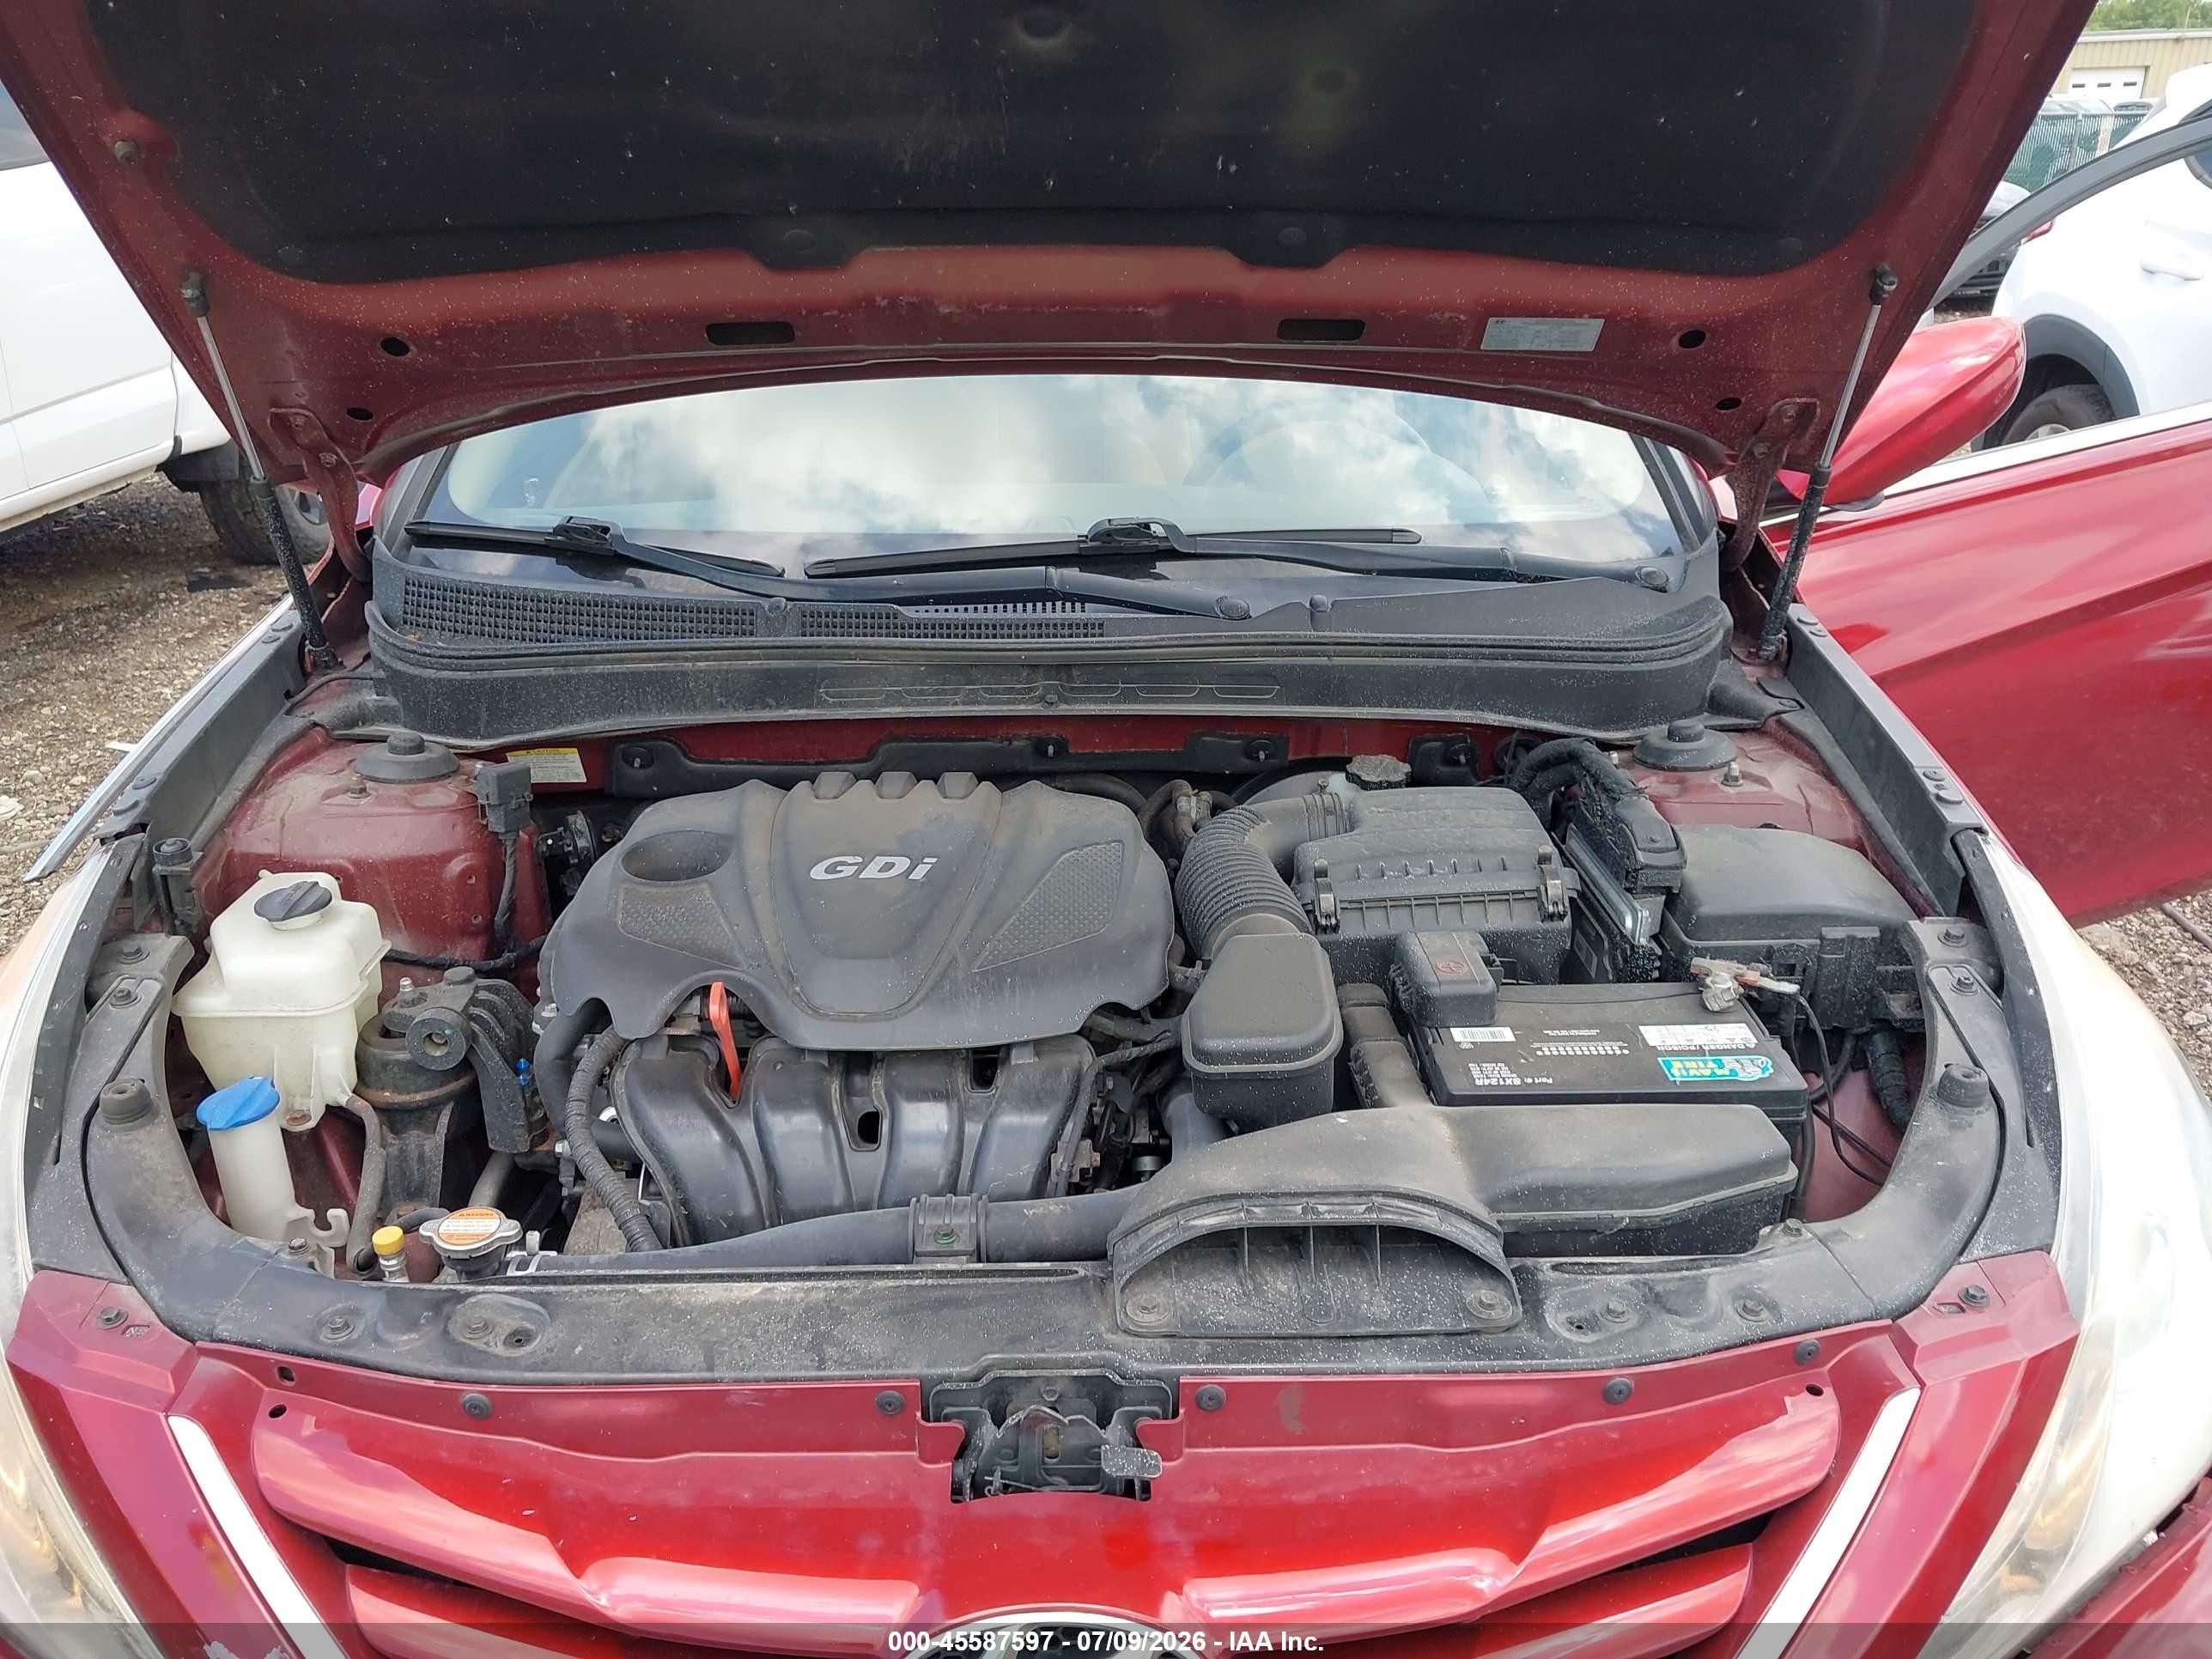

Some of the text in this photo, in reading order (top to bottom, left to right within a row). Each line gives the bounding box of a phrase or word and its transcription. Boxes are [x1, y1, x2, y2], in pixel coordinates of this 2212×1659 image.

[810, 855, 938, 880] GDi
[1701, 1042, 1746, 1051] DANGER
[1671, 1060, 1718, 1069] TIRE
